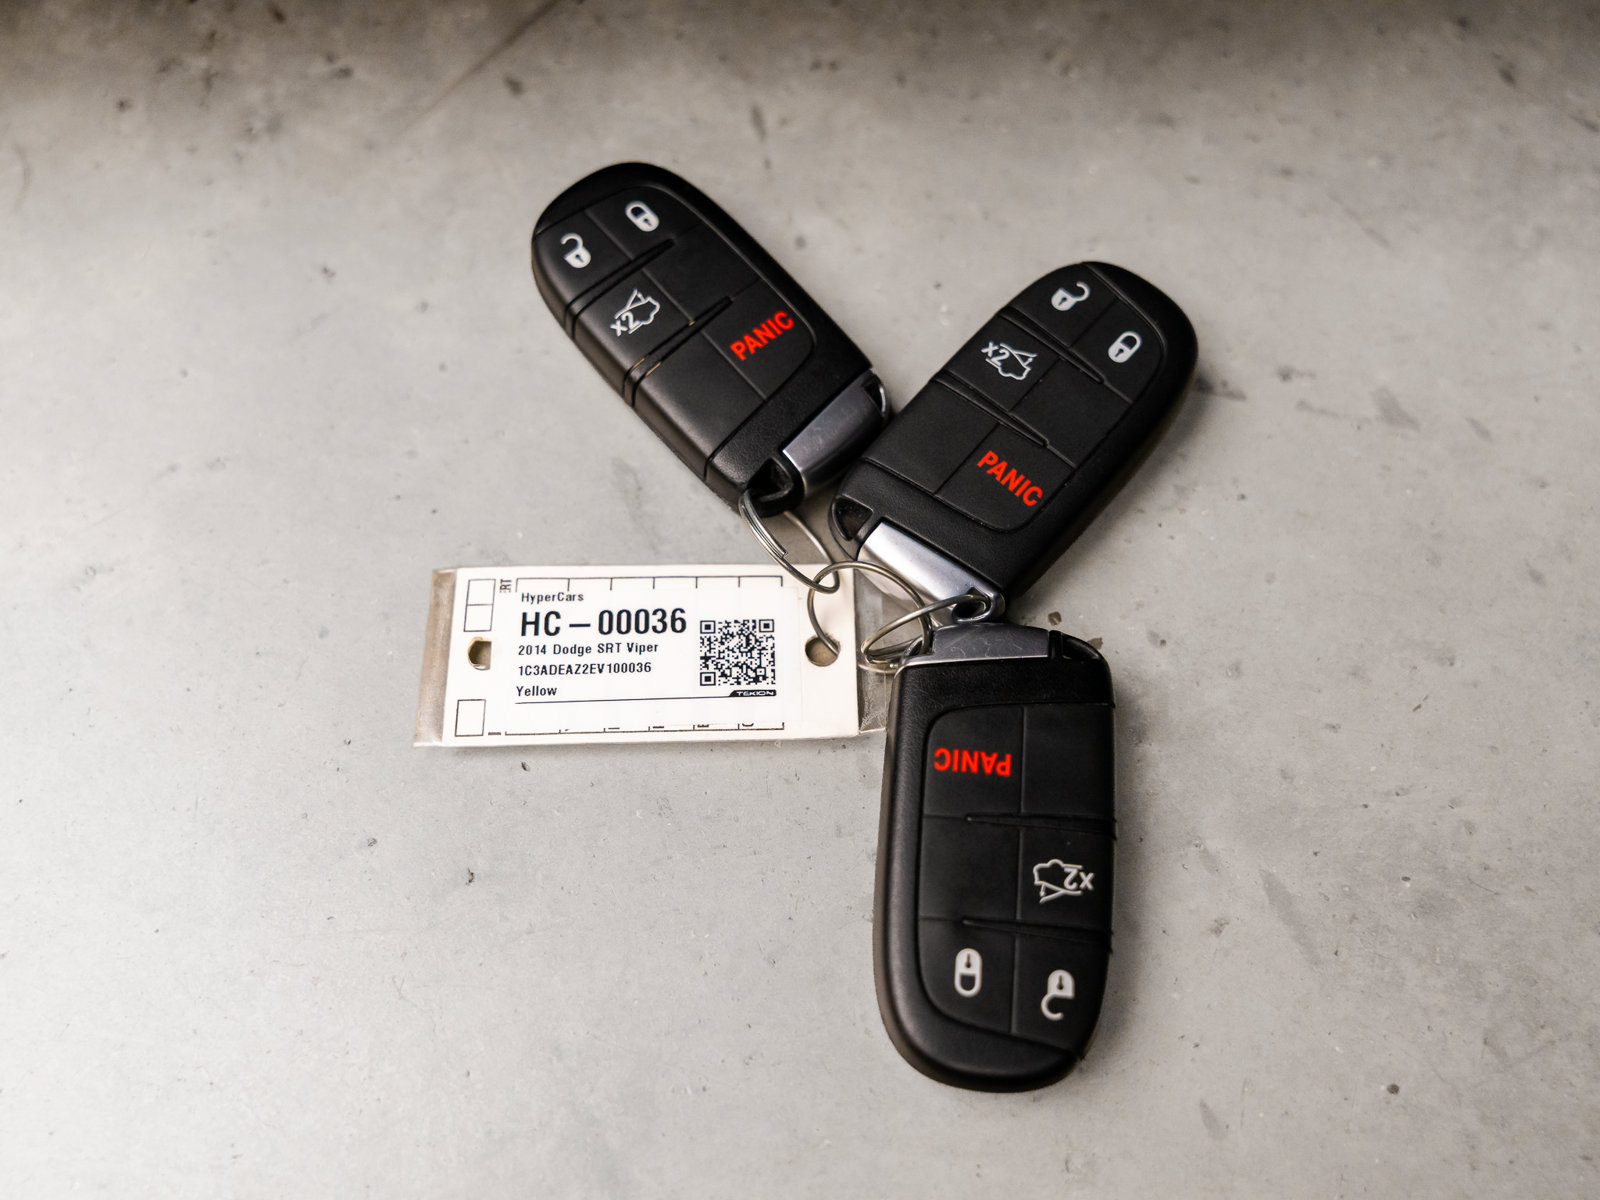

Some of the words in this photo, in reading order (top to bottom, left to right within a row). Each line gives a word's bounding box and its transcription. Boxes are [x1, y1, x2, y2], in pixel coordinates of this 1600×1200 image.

[611, 311, 640, 337] x2
[729, 311, 795, 361] PANIC
[981, 342, 1010, 367] x2
[977, 450, 1043, 506] PANIC
[521, 591, 585, 605] HyperCars
[520, 610, 562, 637] HC
[597, 607, 688, 636] 00036
[518, 644, 547, 656] 2014
[553, 643, 592, 657] Dodge
[597, 642, 623, 654] SRT
[627, 641, 659, 655] Viper
[518, 661, 652, 676] 1C3ADEAZ2EV100036
[516, 685, 558, 697] Yellow
[934, 747, 1012, 777] PANIC
[1063, 867, 1095, 890] x2
